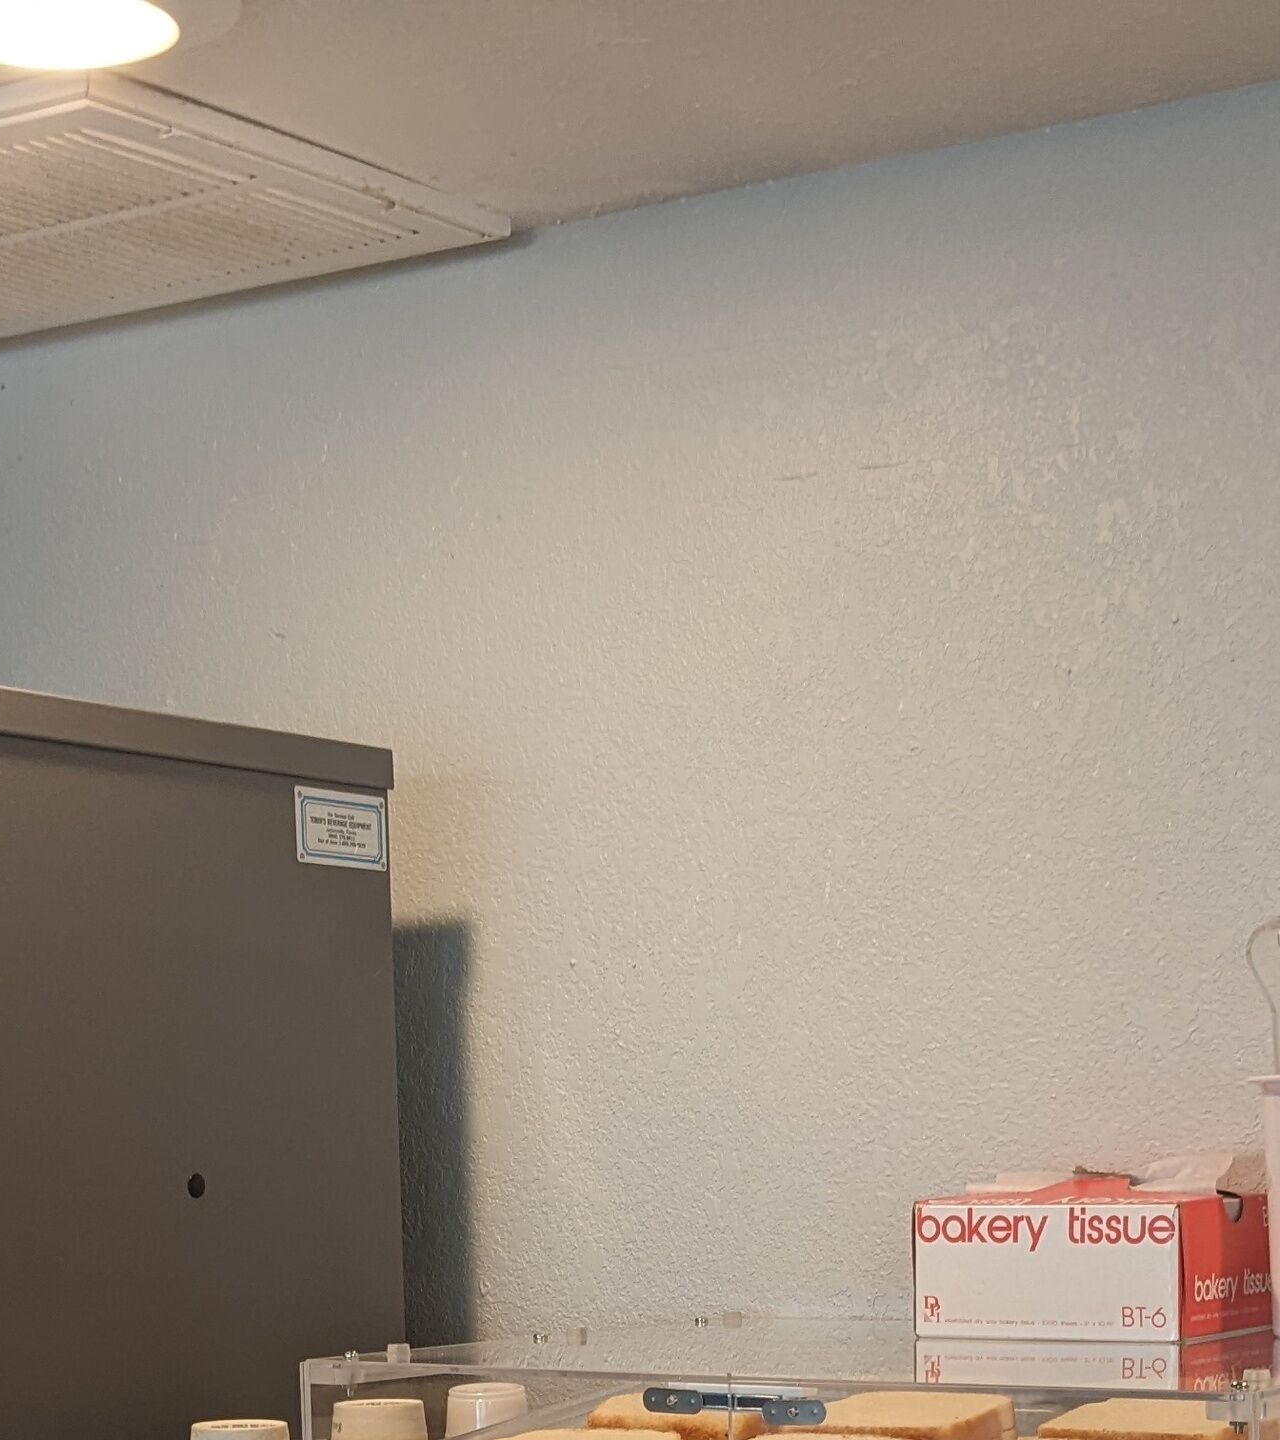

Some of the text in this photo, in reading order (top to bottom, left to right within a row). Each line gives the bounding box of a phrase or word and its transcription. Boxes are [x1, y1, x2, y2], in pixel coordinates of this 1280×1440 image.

[917, 1207, 1176, 1252] bakery tissue
[1194, 1272, 1239, 1303] bakery
[1122, 1306, 1167, 1328] BT-6
